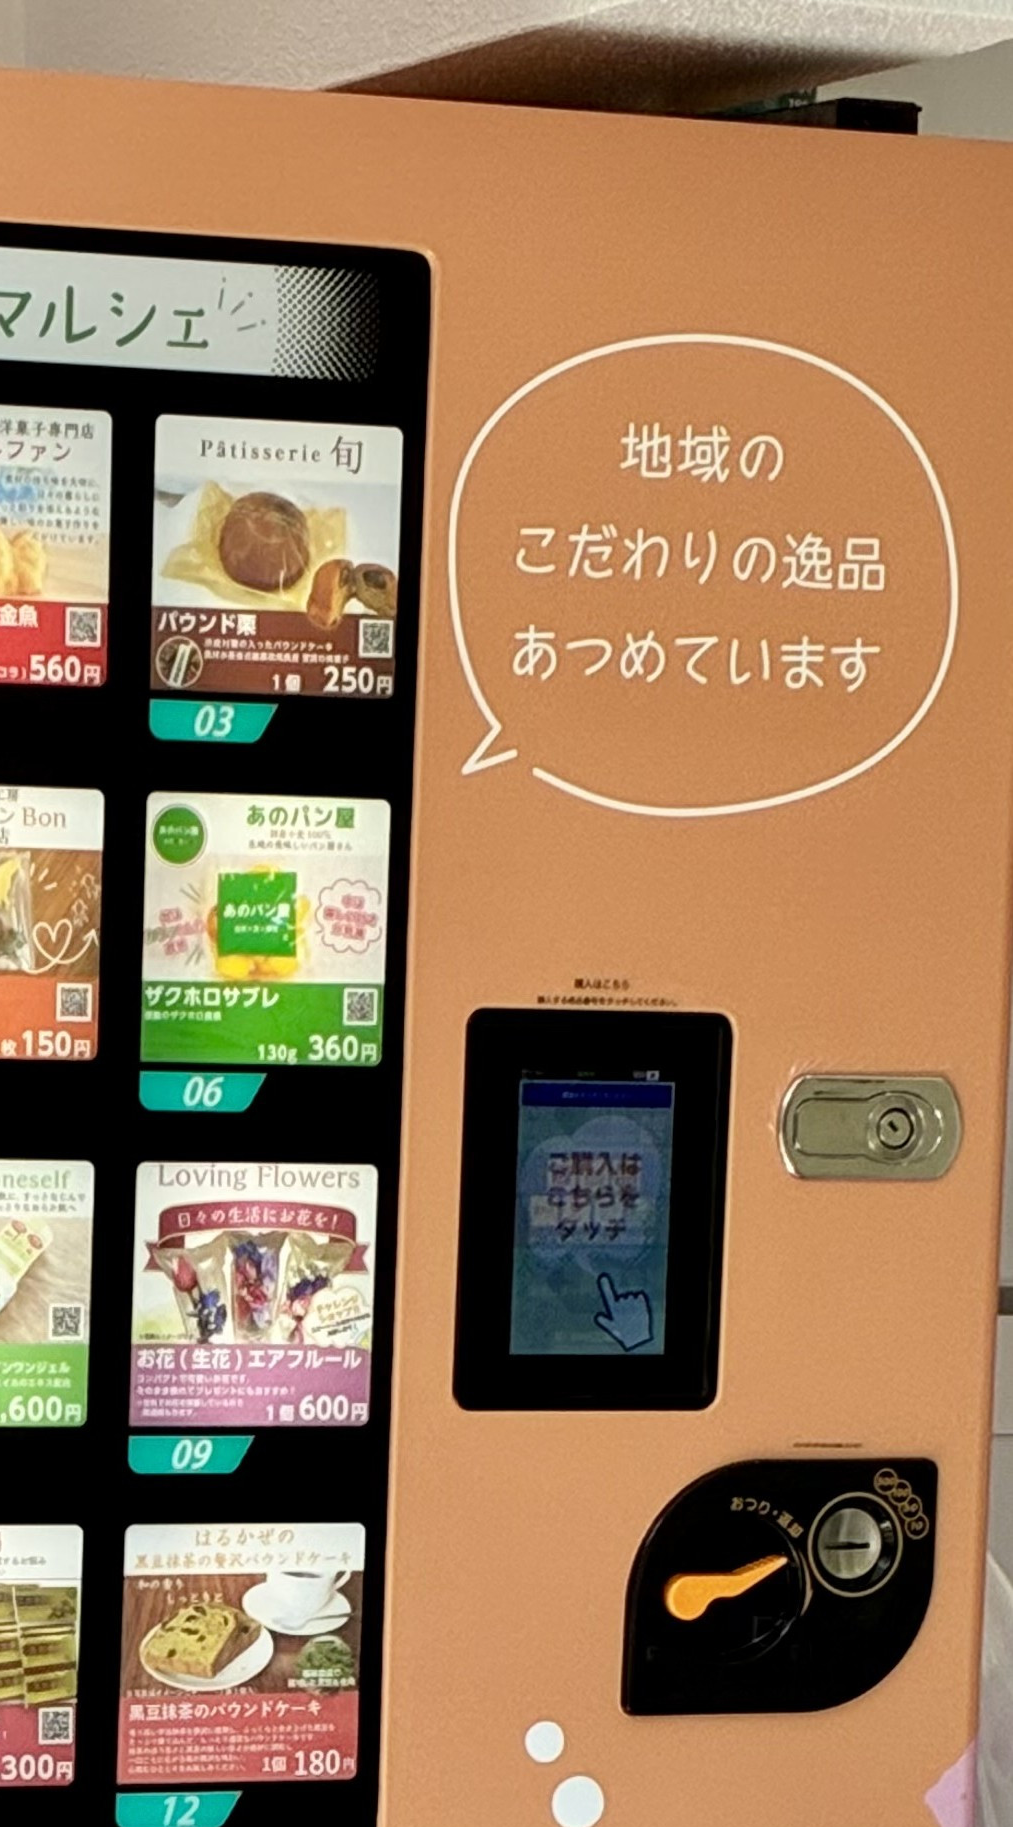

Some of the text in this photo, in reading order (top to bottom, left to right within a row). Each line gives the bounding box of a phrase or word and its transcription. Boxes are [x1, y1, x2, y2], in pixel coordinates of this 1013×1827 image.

[200, 435, 364, 474] Pâtisserie 旬
[619, 422, 785, 483] 地域の
[515, 523, 886, 592] こだわりの逸品
[158, 614, 257, 635] パウンド栗
[512, 624, 881, 692] あつめています
[272, 674, 301, 692] 1個
[194, 705, 235, 738] 03
[23, 807, 67, 828] Bon
[248, 805, 355, 828] あのパン屋
[223, 903, 290, 919] あのパン屋
[145, 986, 279, 1009] ザクホロサブレ
[257, 1045, 298, 1064] 130g
[184, 1077, 225, 1107] 06
[547, 1151, 643, 1178] ご購入は
[158, 1164, 360, 1191] Loving Flowers
[547, 1186, 641, 1209] こちらを
[177, 1208, 338, 1229] 日々の生活にお花を!
[555, 1222, 626, 1242] タッチ
[266, 1404, 294, 1422] 1個
[171, 1438, 213, 1470] 09
[195, 1528, 295, 1547] はるかぜの
[138, 1578, 184, 1590] 和の香り
[166, 1594, 224, 1604] しっとりと
[129, 1700, 322, 1722] 黒豆抹茶のパウンドケーキ
[262, 1756, 286, 1773] 1個
[163, 1795, 201, 1827] 12
